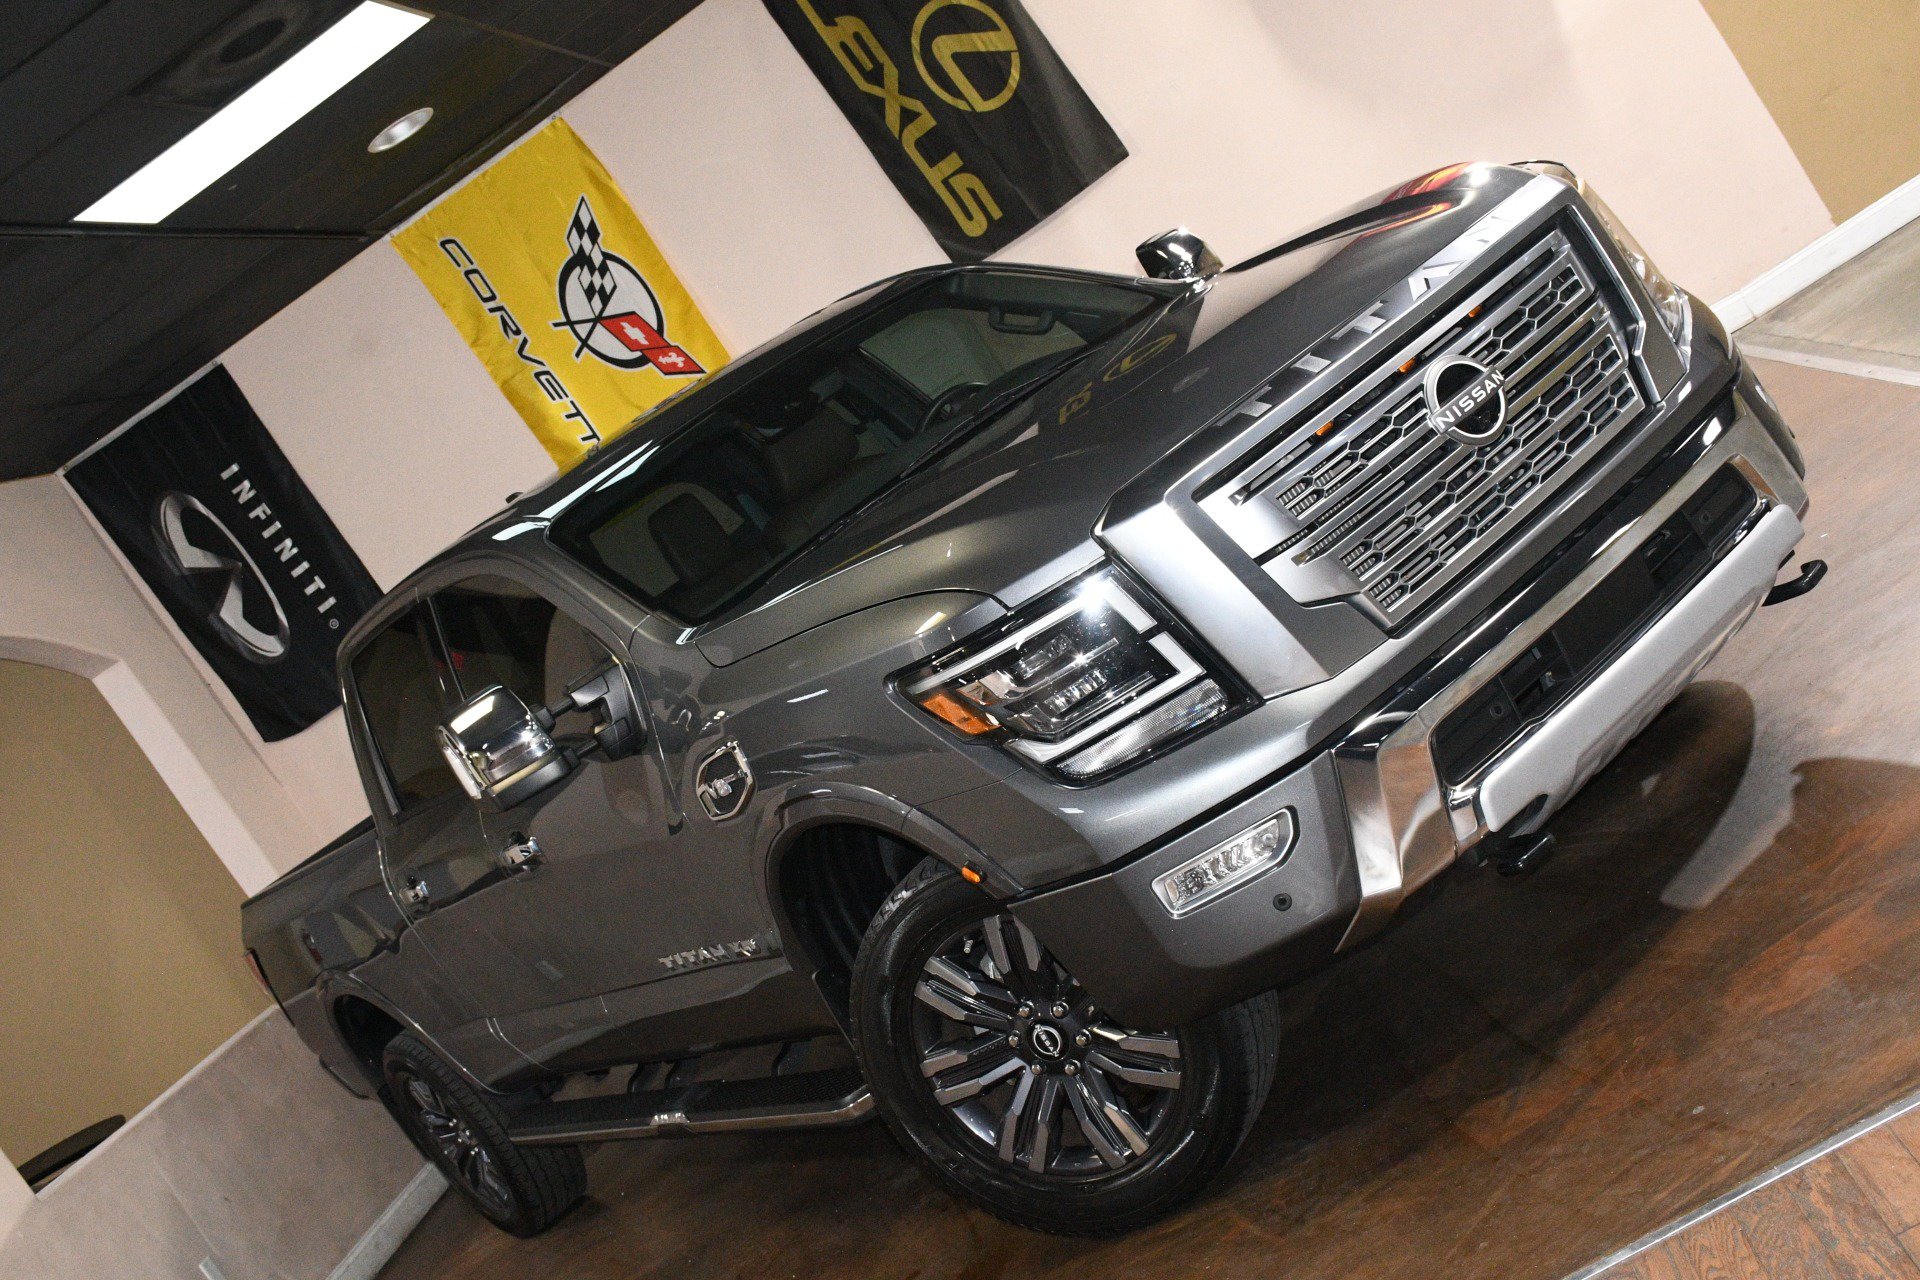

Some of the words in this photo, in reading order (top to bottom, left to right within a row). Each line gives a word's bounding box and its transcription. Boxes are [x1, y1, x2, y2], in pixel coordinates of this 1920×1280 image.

[439, 238, 601, 443] CORVETT
[1213, 214, 1514, 427] TITAN
[1435, 369, 1504, 430] NISSAN
[657, 943, 730, 969] TITAN
